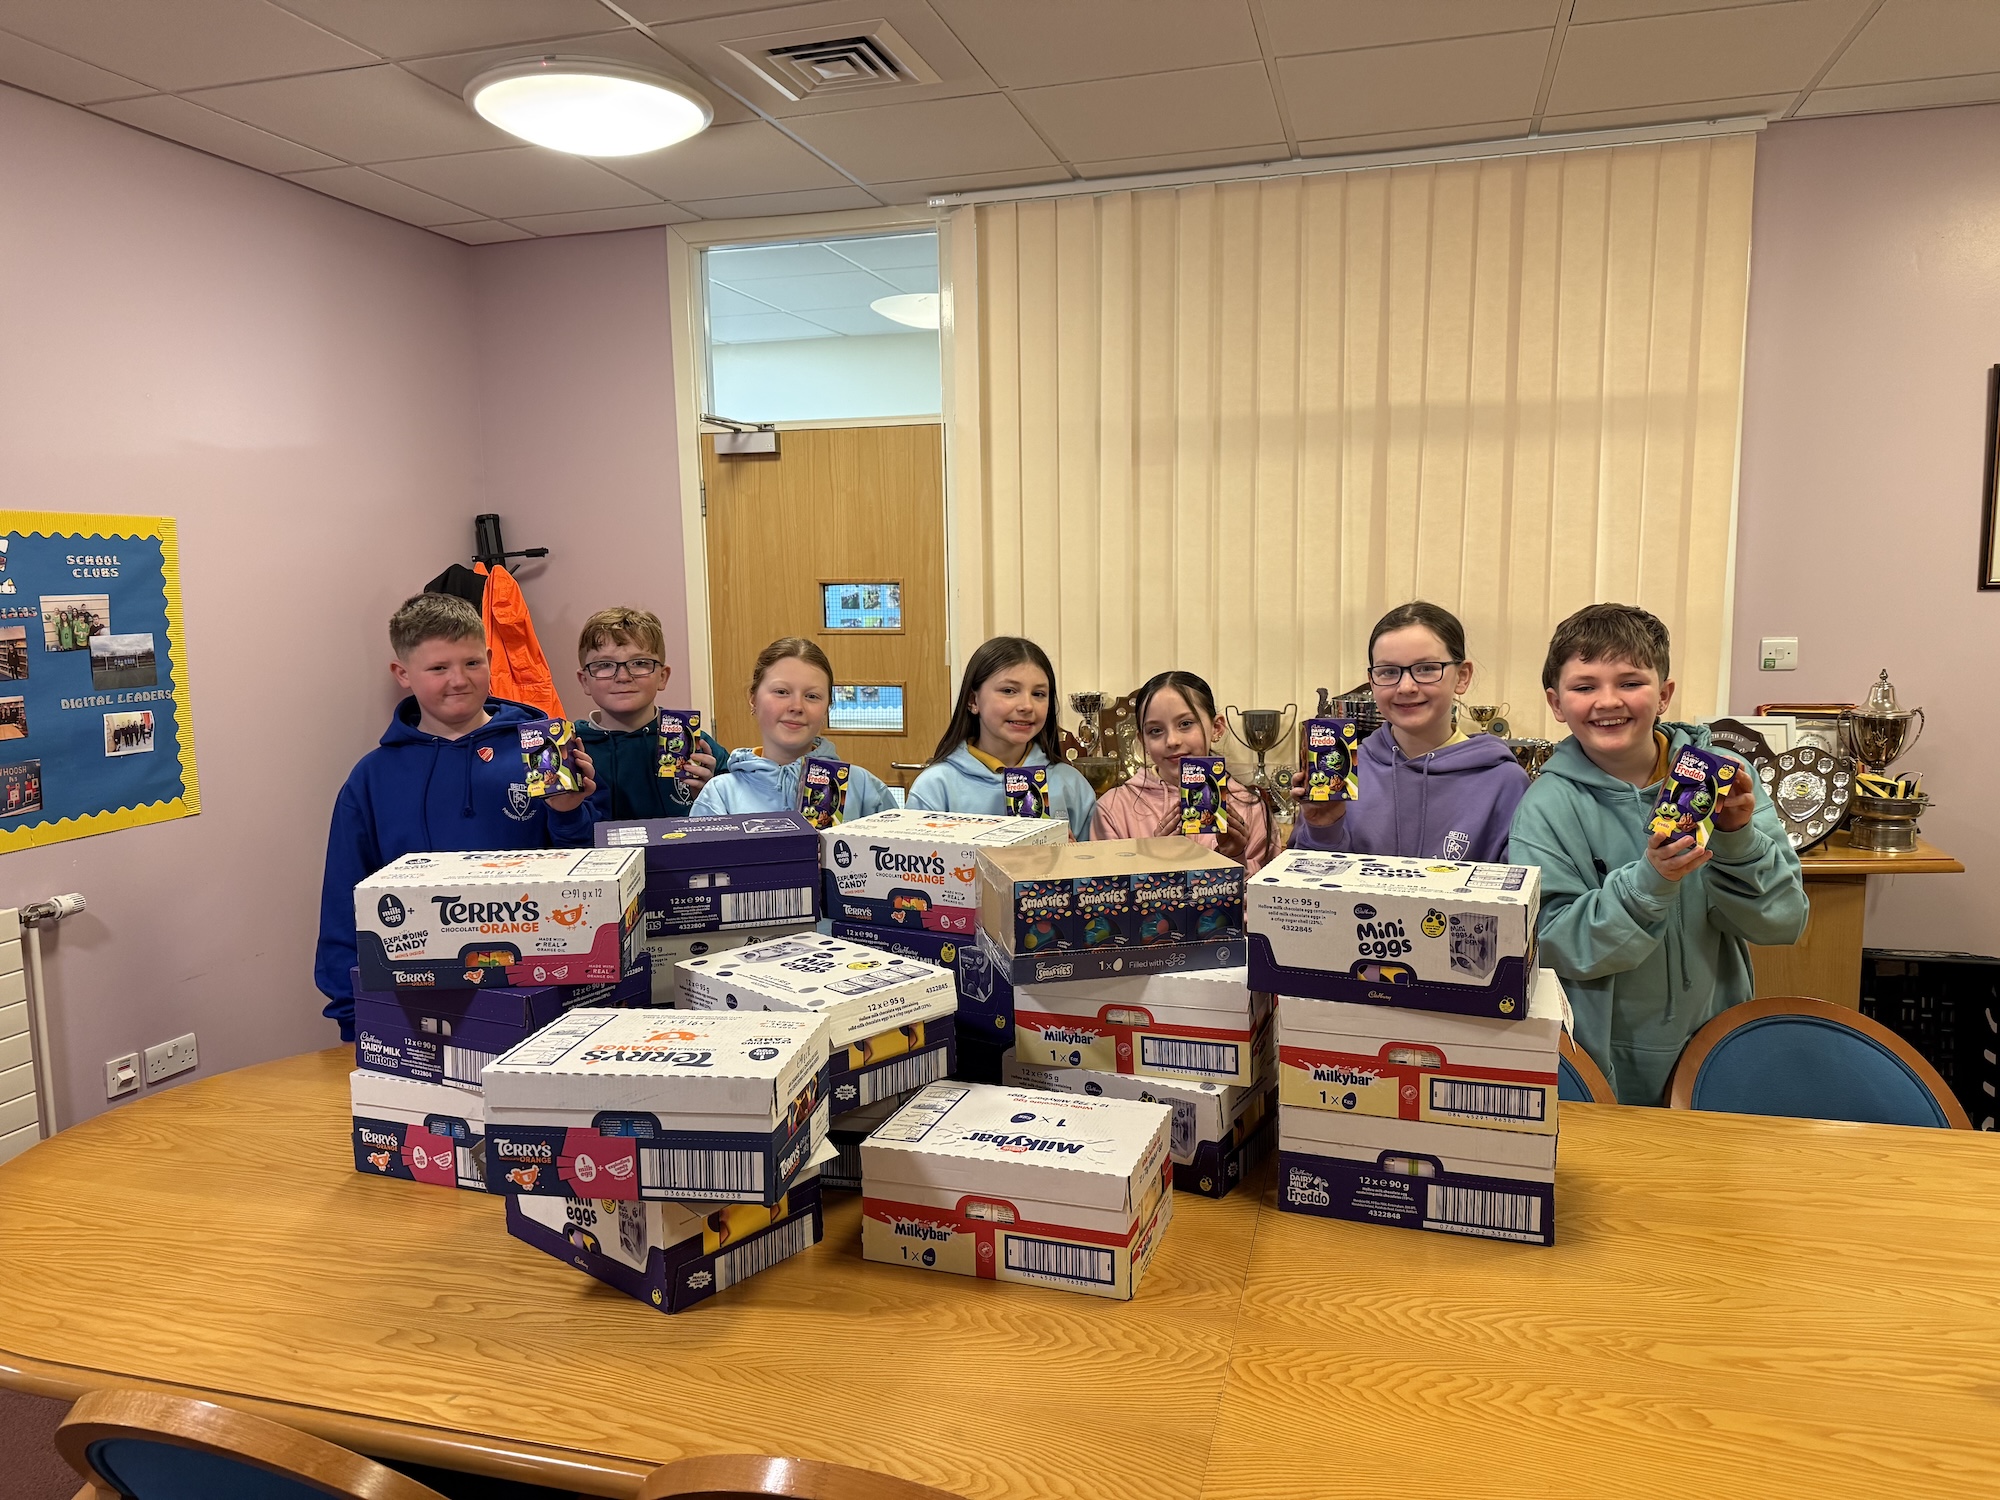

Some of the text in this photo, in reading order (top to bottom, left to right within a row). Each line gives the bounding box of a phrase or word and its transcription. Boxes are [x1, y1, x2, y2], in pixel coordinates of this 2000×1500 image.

[66, 555, 121, 566] SCHOOL
[72, 568, 120, 578] CLUBS
[61, 689, 173, 710] DIGITAL LEADERS
[1310, 736, 1336, 747] Freddo
[1675, 763, 1705, 781] Freddo
[1182, 774, 1206, 783] Freddo
[1006, 782, 1029, 792] Freddo
[839, 843, 843, 851] 1
[869, 845, 945, 876] TERRY'S
[839, 880, 867, 889] CANDY
[902, 872, 945, 885] ORANGE
[573, 888, 603, 900] 91 g x 12
[1136, 885, 1183, 903] SMARTIES
[1192, 881, 1239, 900] SMARTIES
[386, 897, 392, 907] 1
[1020, 893, 1070, 912] SMARTIES
[1078, 889, 1127, 908] SMARTIES
[1272, 896, 1283, 904] 12
[1300, 898, 1312, 906] 95
[1314, 900, 1320, 908] g
[382, 907, 401, 917] milk
[431, 893, 539, 926] TERRY'S
[843, 904, 872, 917] TERRY'S
[1355, 907, 1376, 917] Cadbury
[385, 914, 401, 923] egg
[479, 922, 539, 934] ORANGE
[1281, 925, 1313, 933] 4322845
[1356, 918, 1405, 941] Mini
[1450, 924, 1466, 932] Mini
[386, 938, 427, 953] CANDY
[891, 943, 919, 956] Cadbury
[1358, 939, 1412, 958] eggs
[1099, 960, 1104, 970] 1
[1149, 959, 1164, 967] with
[392, 970, 435, 983] TERRY'S
[1036, 964, 1073, 981] SMARTIES
[573, 988, 580, 996] 12
[1368, 990, 1392, 1001] Cadbury
[867, 1003, 877, 1012] 12
[889, 998, 899, 1007] 95
[1044, 1030, 1093, 1045] Milkybar
[360, 1042, 383, 1053] DAIRY
[383, 1046, 401, 1057] MILK
[404, 1038, 412, 1046] 12
[422, 1041, 431, 1050] 90
[364, 1050, 399, 1068] buttons
[580, 1050, 714, 1067] TERRY'S
[1050, 1050, 1066, 1062] 1 x
[1021, 1068, 1030, 1076] 12
[1054, 1075, 1059, 1083] g
[1313, 1069, 1372, 1086] Milkybar
[1030, 1100, 1069, 1108] Chocolate
[1319, 1091, 1339, 1105] 1 x
[1056, 1118, 1067, 1127] 1
[359, 1127, 398, 1146] TERRY'S
[376, 1143, 398, 1151] ORANGE
[493, 1138, 552, 1157] TERRY'S
[968, 1132, 1085, 1154] Milkybar
[520, 1156, 552, 1164] ORANGE
[581, 1157, 586, 1165] 1
[608, 1158, 631, 1170] exploding
[578, 1165, 593, 1173] milk
[1289, 1167, 1313, 1177] Cadbury
[1289, 1180, 1309, 1189] MILK
[1290, 1174, 1313, 1184] DAIRY
[1359, 1176, 1371, 1185] 12
[1389, 1180, 1402, 1189] 90
[1403, 1183, 1410, 1191] g
[664, 1190, 742, 1199] 03664346346238
[1288, 1187, 1329, 1205] Freddo
[566, 1205, 597, 1227] eggs
[1368, 1209, 1401, 1220] 4322848
[895, 1222, 950, 1242] Milkybar
[1460, 1227, 1486, 1235] 22202
[1491, 1230, 1518, 1239] 33861
[901, 1246, 919, 1261] 1 x
[1040, 1275, 1061, 1283] 45291
[1066, 1279, 1088, 1287] 96380
